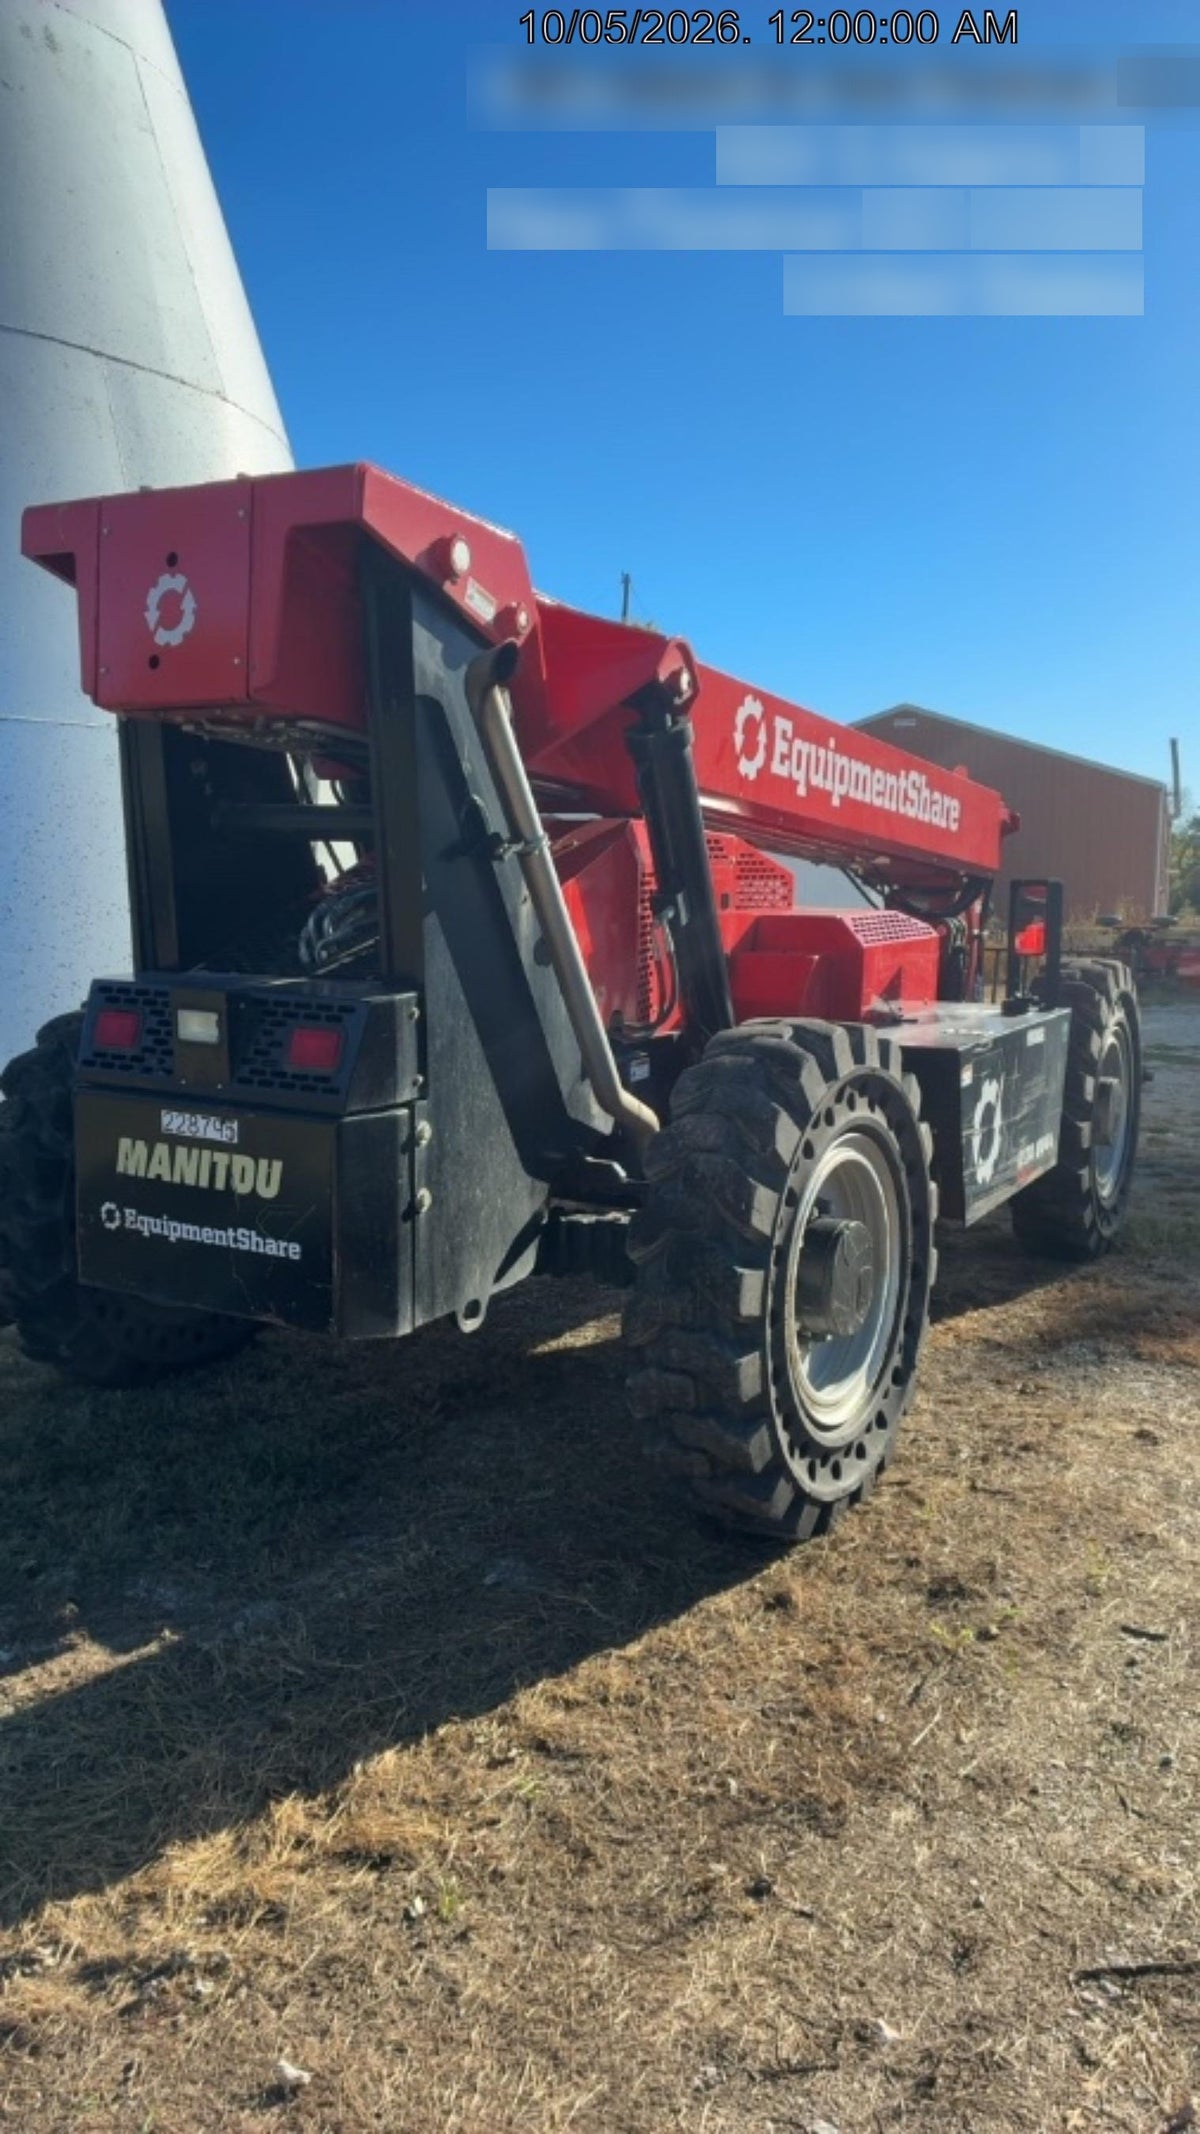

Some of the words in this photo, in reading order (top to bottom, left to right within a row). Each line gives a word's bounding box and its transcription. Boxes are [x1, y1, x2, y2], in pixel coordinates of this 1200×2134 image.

[770, 715, 960, 833] EquipmentShare
[116, 1137, 283, 1199] MANITOU
[123, 1207, 302, 1260] EquipmentShare
